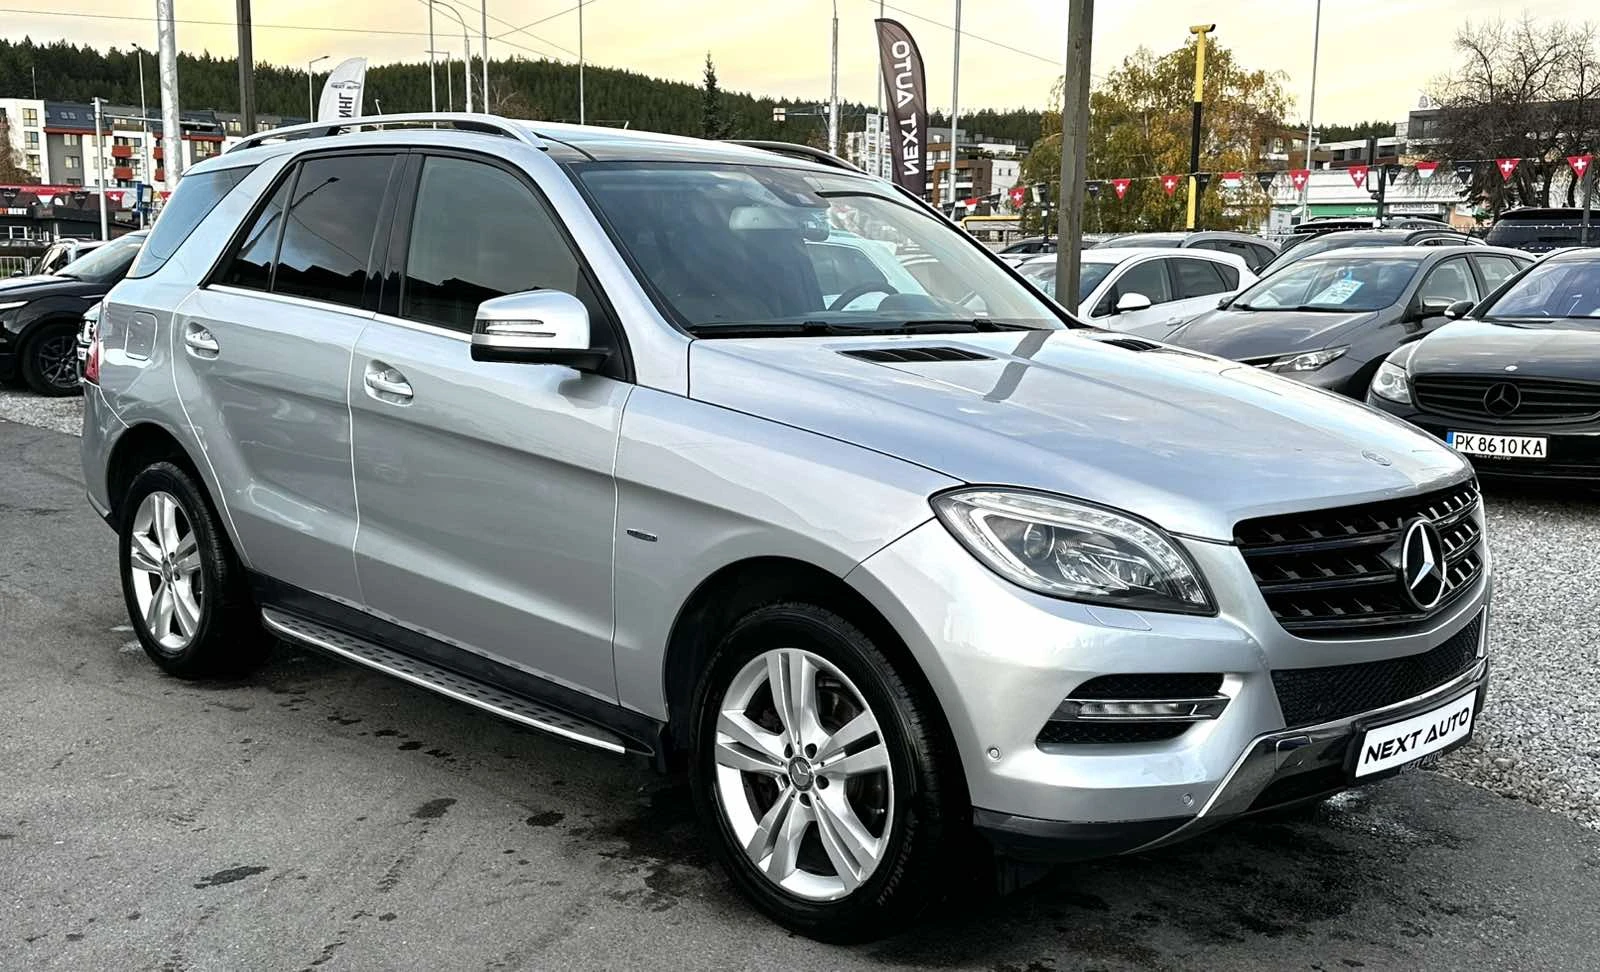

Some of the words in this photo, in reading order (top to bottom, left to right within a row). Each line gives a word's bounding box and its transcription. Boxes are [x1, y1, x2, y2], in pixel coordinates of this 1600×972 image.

[1455, 434, 1475, 451] PK
[1478, 437, 1518, 455] 8610
[1521, 440, 1543, 456] KA
[1365, 729, 1423, 764] NEXT
[1423, 707, 1470, 745] AUTO
